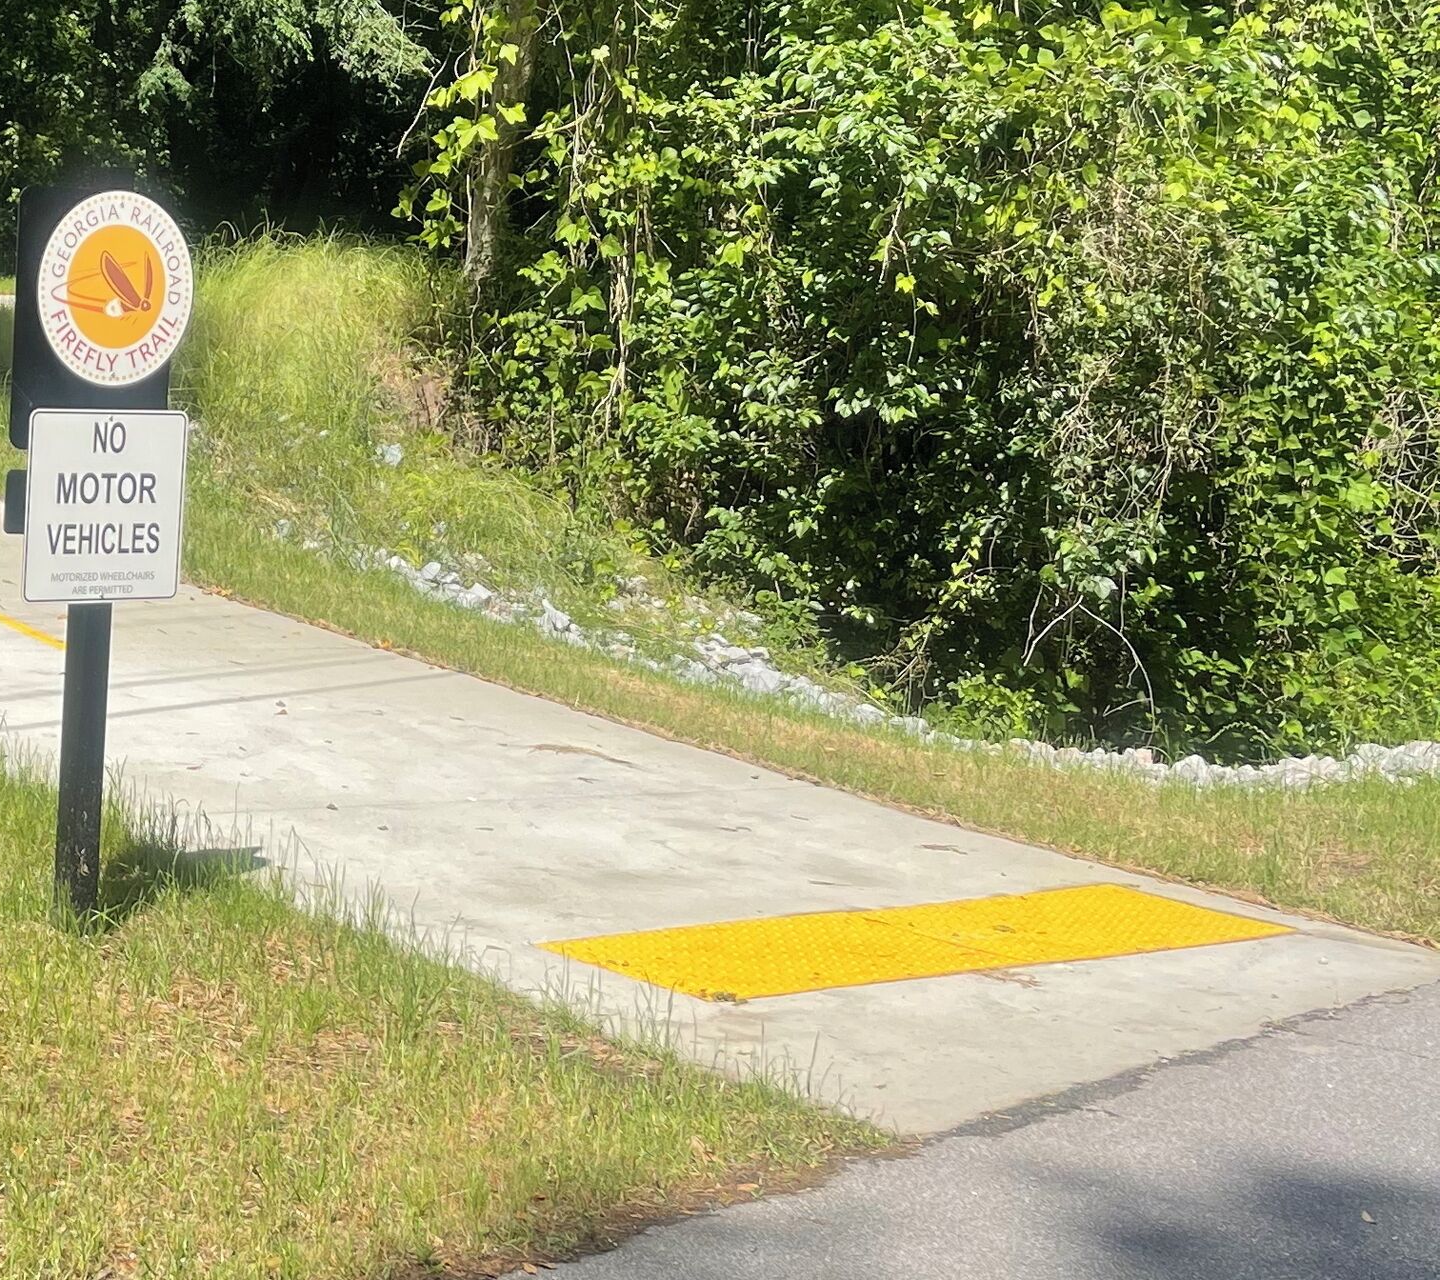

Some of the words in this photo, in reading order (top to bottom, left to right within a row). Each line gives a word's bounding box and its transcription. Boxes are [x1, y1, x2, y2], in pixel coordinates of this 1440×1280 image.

[51, 204, 120, 278] GEORGIA
[130, 207, 181, 305] RAILROAD
[50, 309, 119, 372] FIREFLY
[125, 317, 179, 368] TRAIL
[92, 421, 126, 454] NO
[56, 472, 157, 505] MOTOR
[46, 522, 160, 555] VEHICLES
[50, 572, 98, 582] MOTORIZED
[100, 571, 155, 581] WHEELCHAIRS
[72, 586, 87, 595] ARE
[89, 585, 134, 595] PERMITTED
